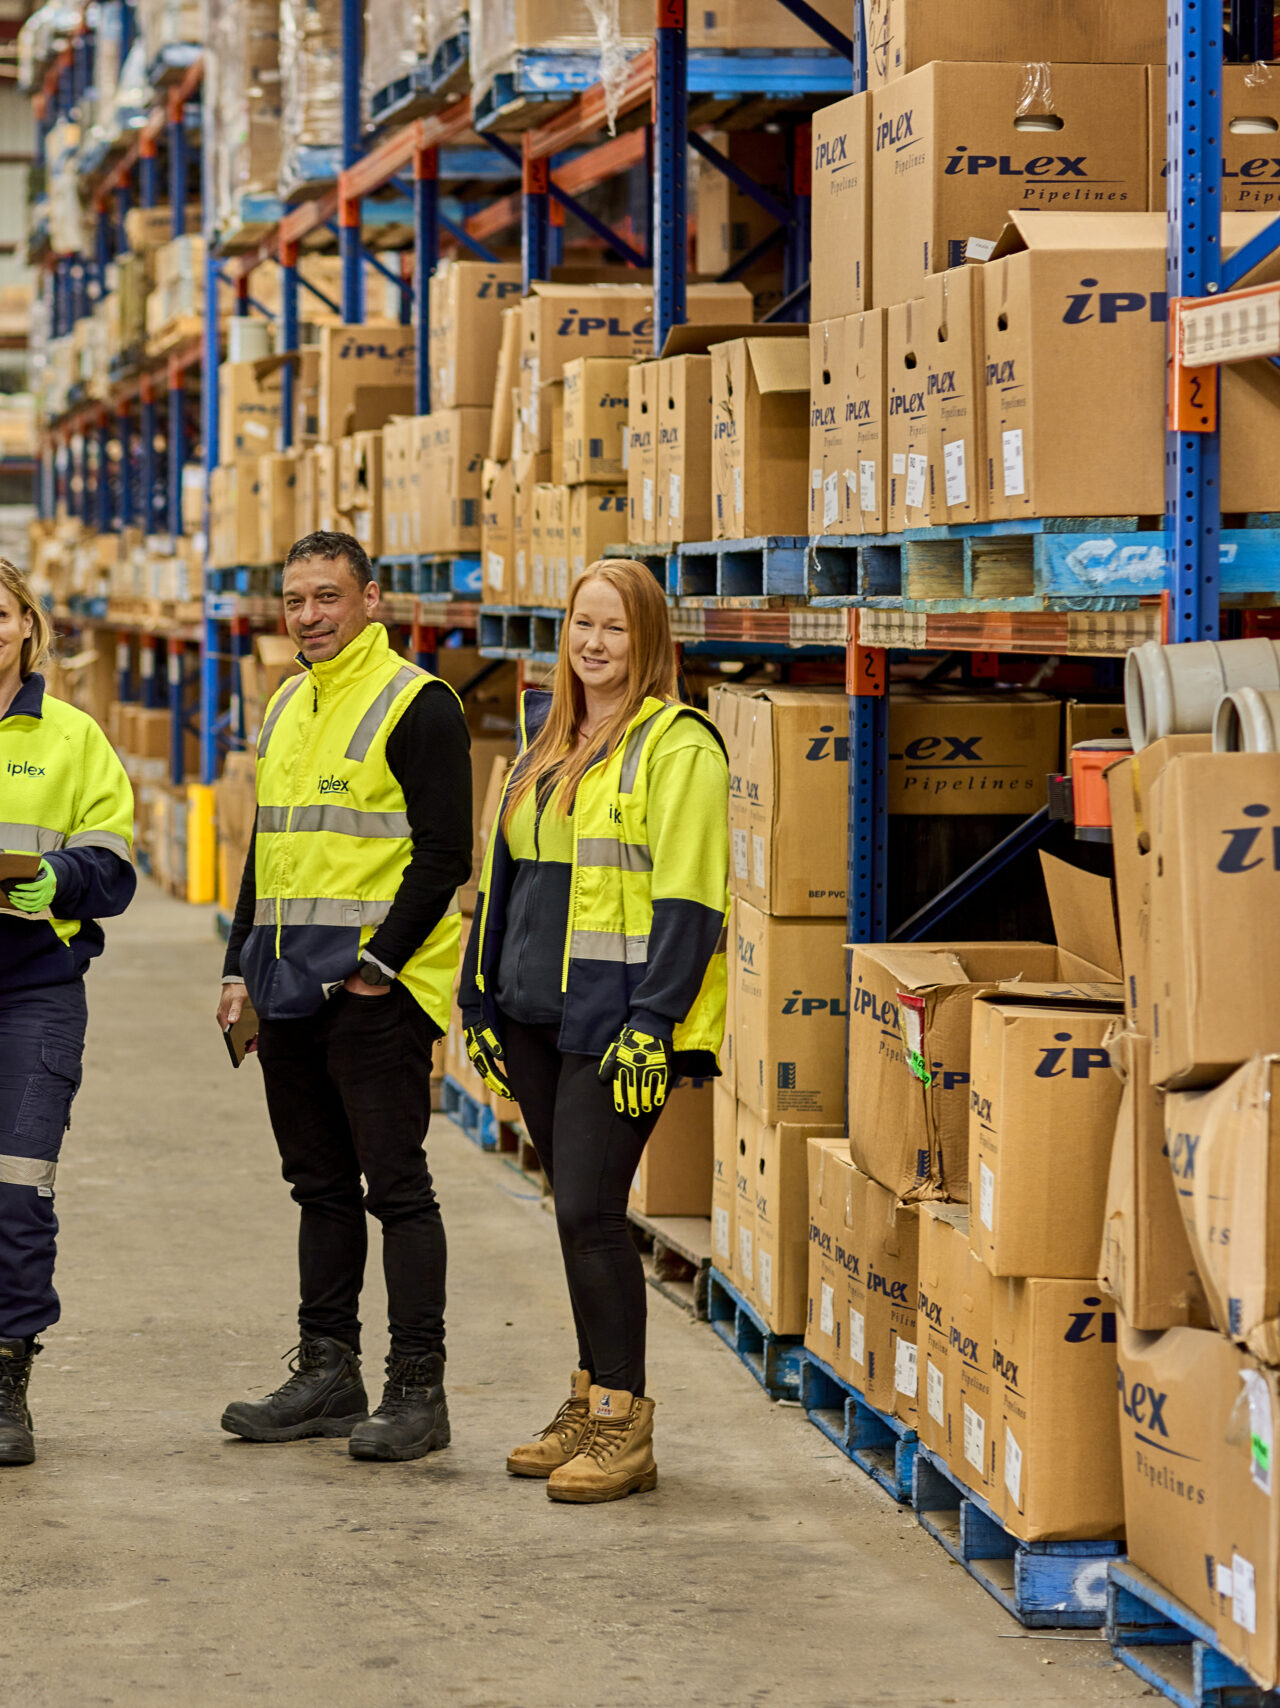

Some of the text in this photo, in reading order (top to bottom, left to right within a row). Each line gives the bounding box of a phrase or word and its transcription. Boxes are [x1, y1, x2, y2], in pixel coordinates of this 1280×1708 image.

[1023, 187, 1128, 202] Pipelines
[1239, 189, 1280, 203] Pip
[7, 759, 46, 777] iplex
[318, 774, 349, 794] iplex
[903, 776, 1034, 794] Pipelines
[827, 890, 846, 899] PVC
[1136, 1449, 1206, 1504] Pipelines
